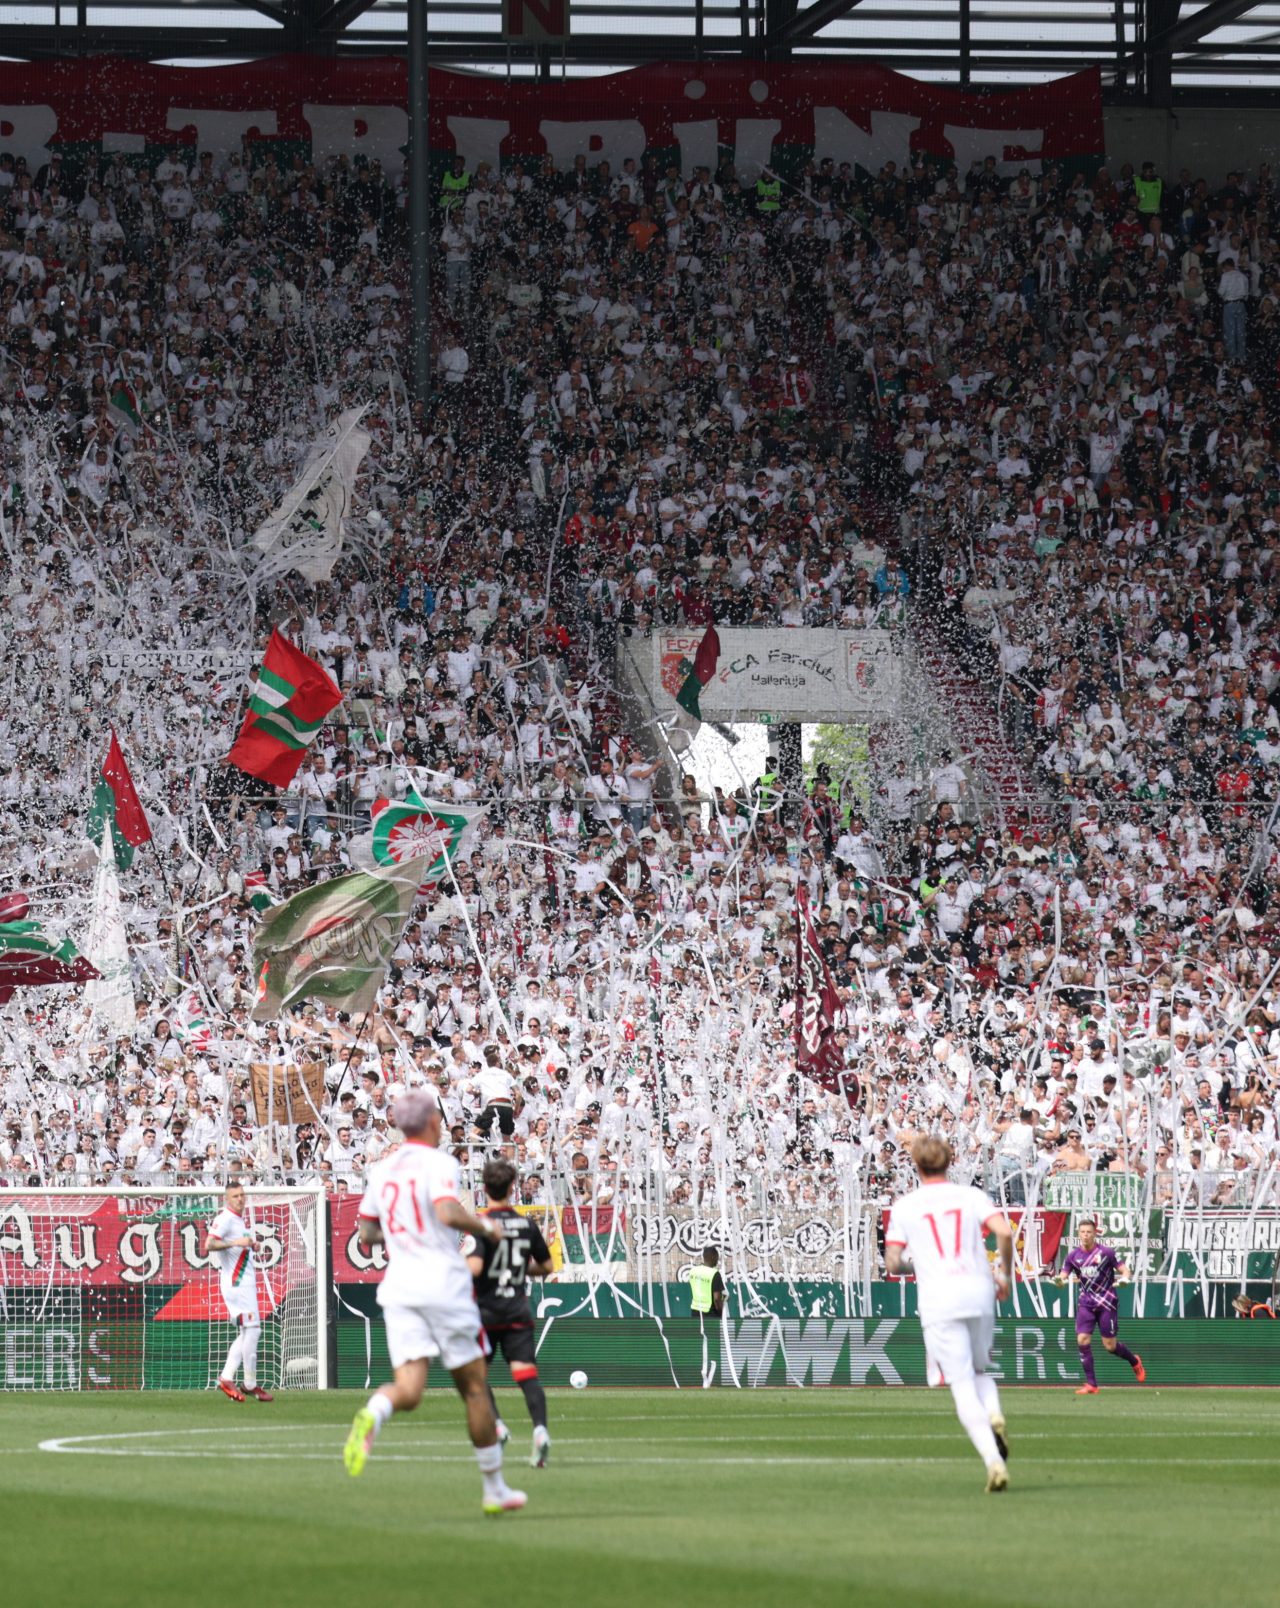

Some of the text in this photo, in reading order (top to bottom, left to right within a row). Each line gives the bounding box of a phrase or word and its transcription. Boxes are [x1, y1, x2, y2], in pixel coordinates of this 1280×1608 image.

[720, 654, 759, 684] FCA
[381, 1178, 424, 1235] 21
[923, 1208, 963, 1259] 17
[488, 1238, 531, 1286] 45
[721, 1319, 905, 1385] WWK
